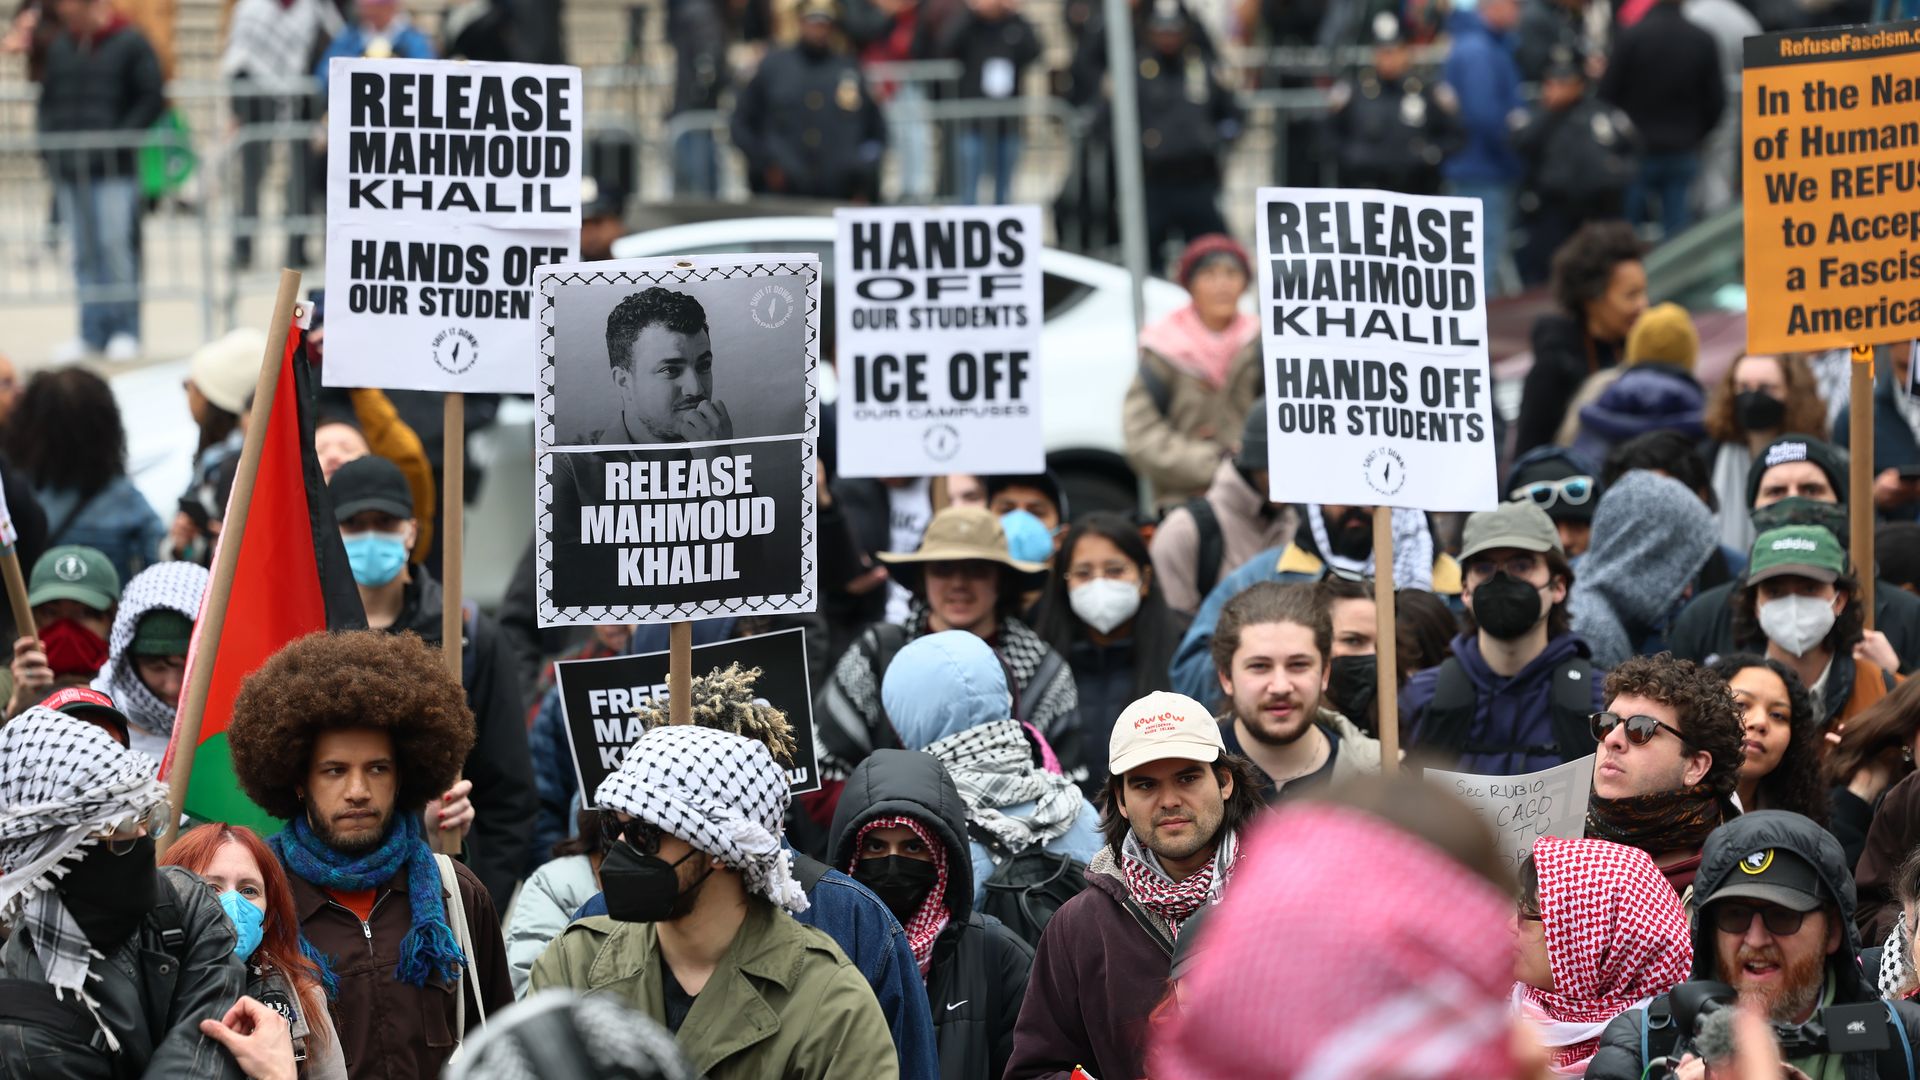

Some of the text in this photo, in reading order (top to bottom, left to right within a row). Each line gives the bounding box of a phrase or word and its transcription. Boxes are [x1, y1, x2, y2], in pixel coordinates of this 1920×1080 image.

[351, 72, 571, 131] RELEASE
[1758, 73, 1920, 117] In the Na
[350, 132, 570, 178] MAHMOUD
[1754, 121, 1919, 161] of Human
[350, 179, 571, 213] KHALIL
[1765, 159, 1920, 204] We REFU
[852, 219, 1024, 271] HANDS
[1267, 201, 1476, 265] RELEASE
[1782, 216, 1817, 247] to
[351, 240, 489, 286] HANDS
[1786, 266, 1806, 292] a
[350, 284, 534, 319] OUR STUDEN
[750, 289, 765, 307] SHUT
[764, 285, 772, 294] IT
[856, 274, 1022, 302] OFF
[1271, 260, 1476, 311] MAHMOUD
[751, 309, 761, 325] FOR
[853, 305, 1028, 330] OUR STUDENTS
[1274, 306, 1480, 347] KHALIL
[1787, 296, 1920, 336] America
[855, 351, 1029, 404] ICE OFF
[1276, 358, 1481, 409] HANDS OFF
[854, 405, 1030, 421] OUR CAMPUSES
[1279, 402, 1484, 443] OUR STUDENTS
[606, 455, 753, 500] RELEASE
[581, 497, 775, 545] MAHMOUD
[618, 542, 740, 587] KHALIL
[1134, 712, 1185, 729] KOW KOW
[1490, 780, 1544, 799] RUBIO
[1497, 796, 1552, 826] CAGO
[1846, 1020, 1866, 1032] 4K
